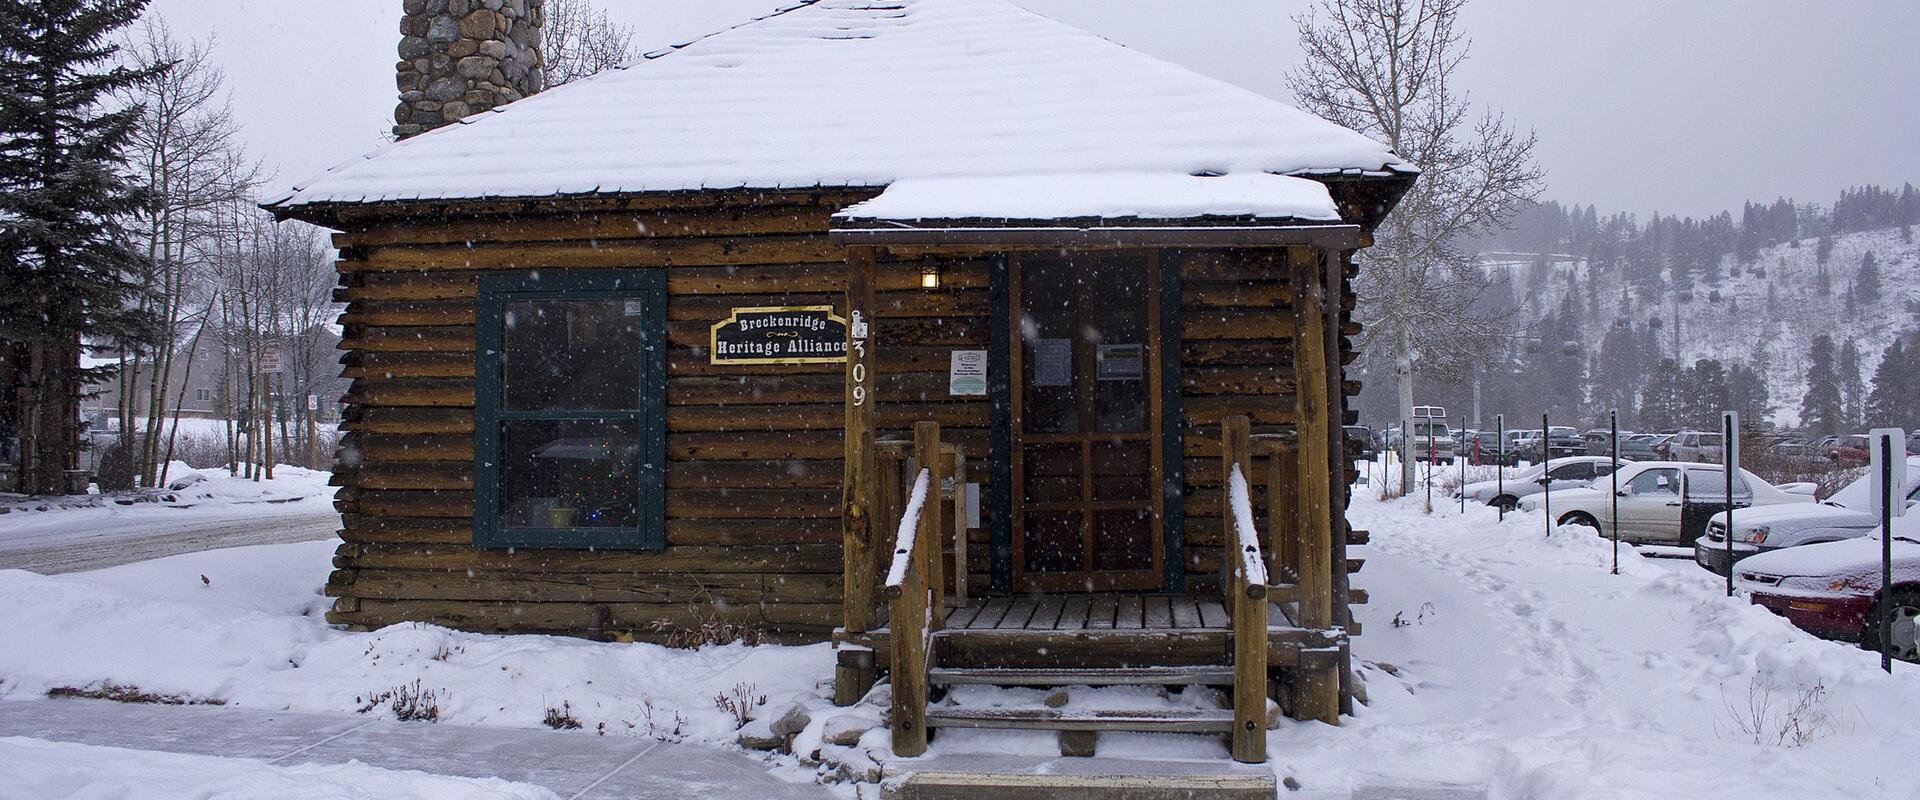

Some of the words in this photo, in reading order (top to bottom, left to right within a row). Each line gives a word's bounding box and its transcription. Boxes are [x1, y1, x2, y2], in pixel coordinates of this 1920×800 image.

[739, 314, 826, 332] Breckenridge
[717, 340, 780, 356] Heritage
[787, 339, 847, 353] Alliance
[852, 340, 866, 406] 309
